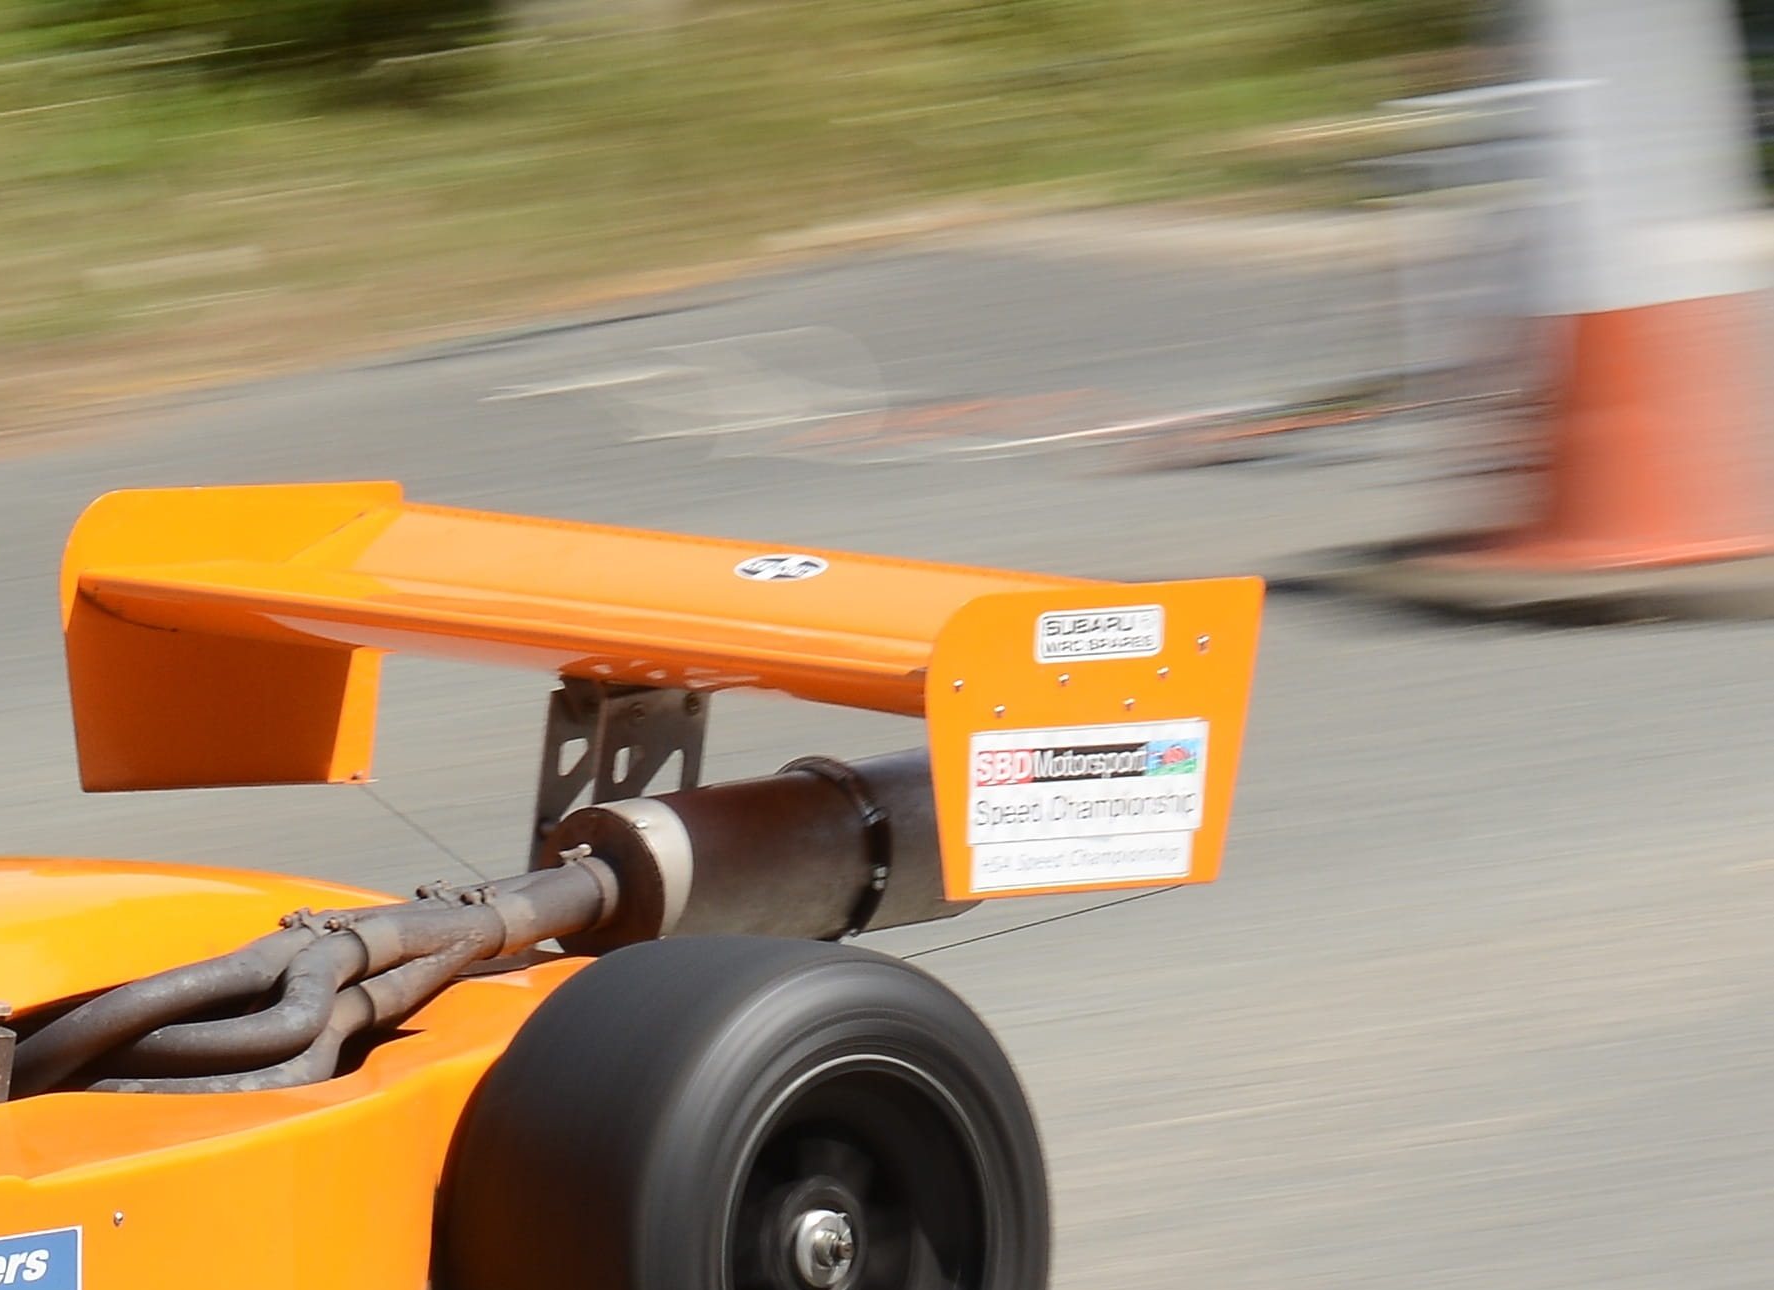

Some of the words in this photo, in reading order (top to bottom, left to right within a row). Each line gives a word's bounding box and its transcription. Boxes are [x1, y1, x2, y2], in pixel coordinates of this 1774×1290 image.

[976, 750, 1032, 783] SBD
[1034, 746, 1148, 779] Motorsport
[974, 799, 1043, 828] Speed
